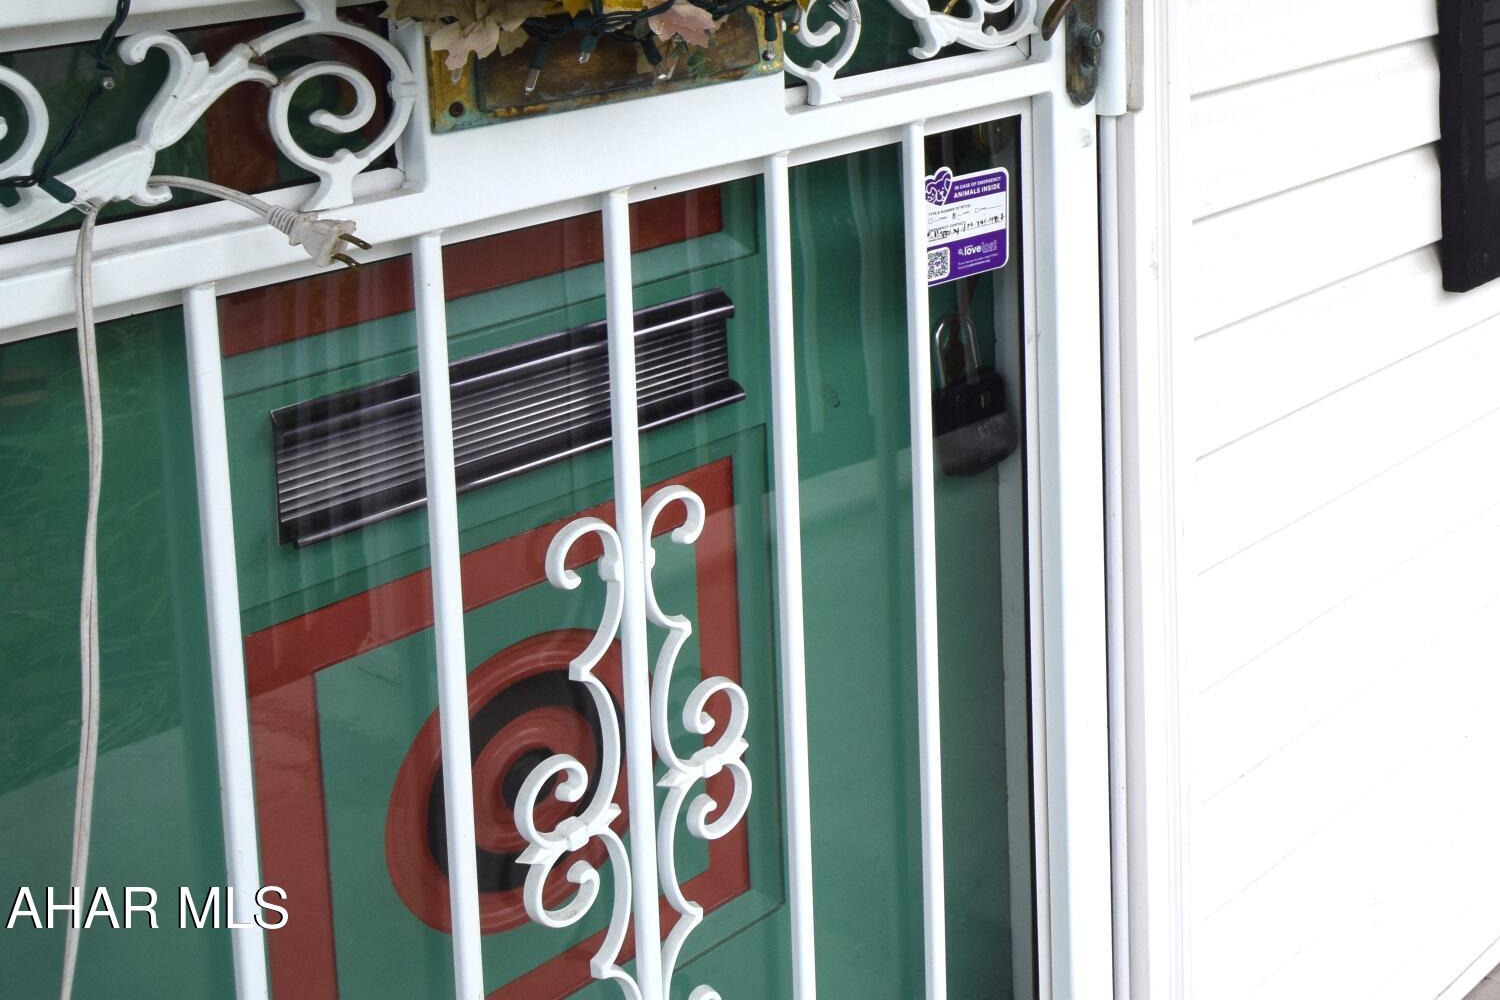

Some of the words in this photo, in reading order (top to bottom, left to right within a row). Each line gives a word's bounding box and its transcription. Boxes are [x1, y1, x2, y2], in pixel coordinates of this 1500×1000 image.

[977, 176, 1001, 186] EMERGENCY
[954, 188, 980, 198] ANIMALS
[982, 183, 1000, 192] INSIDE
